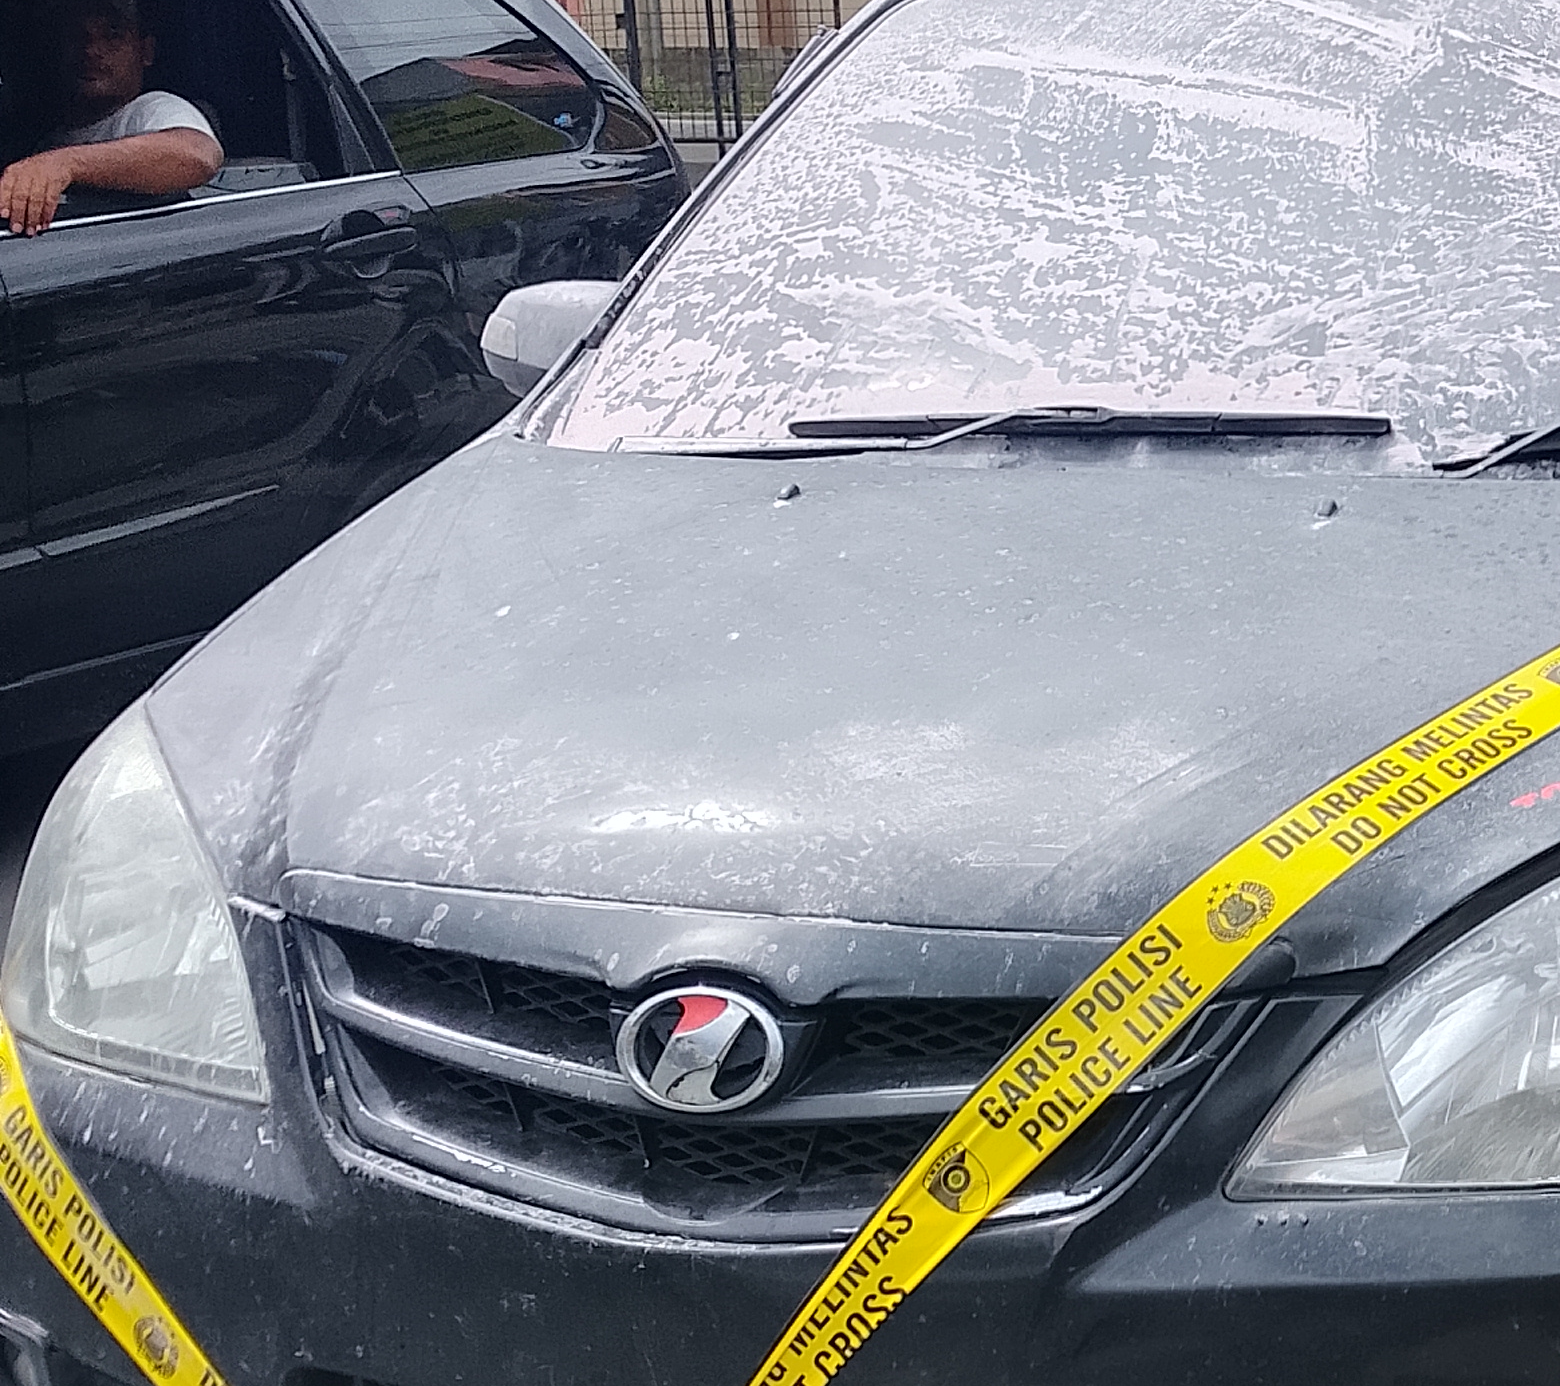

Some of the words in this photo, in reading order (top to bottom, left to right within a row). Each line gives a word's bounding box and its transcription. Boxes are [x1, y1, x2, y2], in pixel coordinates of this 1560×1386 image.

[1261, 758, 1408, 860] DILARANG
[1400, 683, 1533, 762] MELINTAS
[1329, 815, 1382, 855] DO
[1376, 772, 1441, 821] NOT
[1437, 719, 1533, 780] CROSS
[978, 1027, 1078, 1130] GARIS
[1071, 923, 1183, 1034] POLISI
[1018, 1036, 1131, 1153] POLICE
[1123, 965, 1203, 1045] LINE
[0, 1143, 64, 1248] POLICE
[60, 1238, 115, 1311] LINE
[4, 1107, 64, 1199] GARIS
[63, 1193, 137, 1295] POLISI
[787, 1204, 913, 1356] MELINTAS
